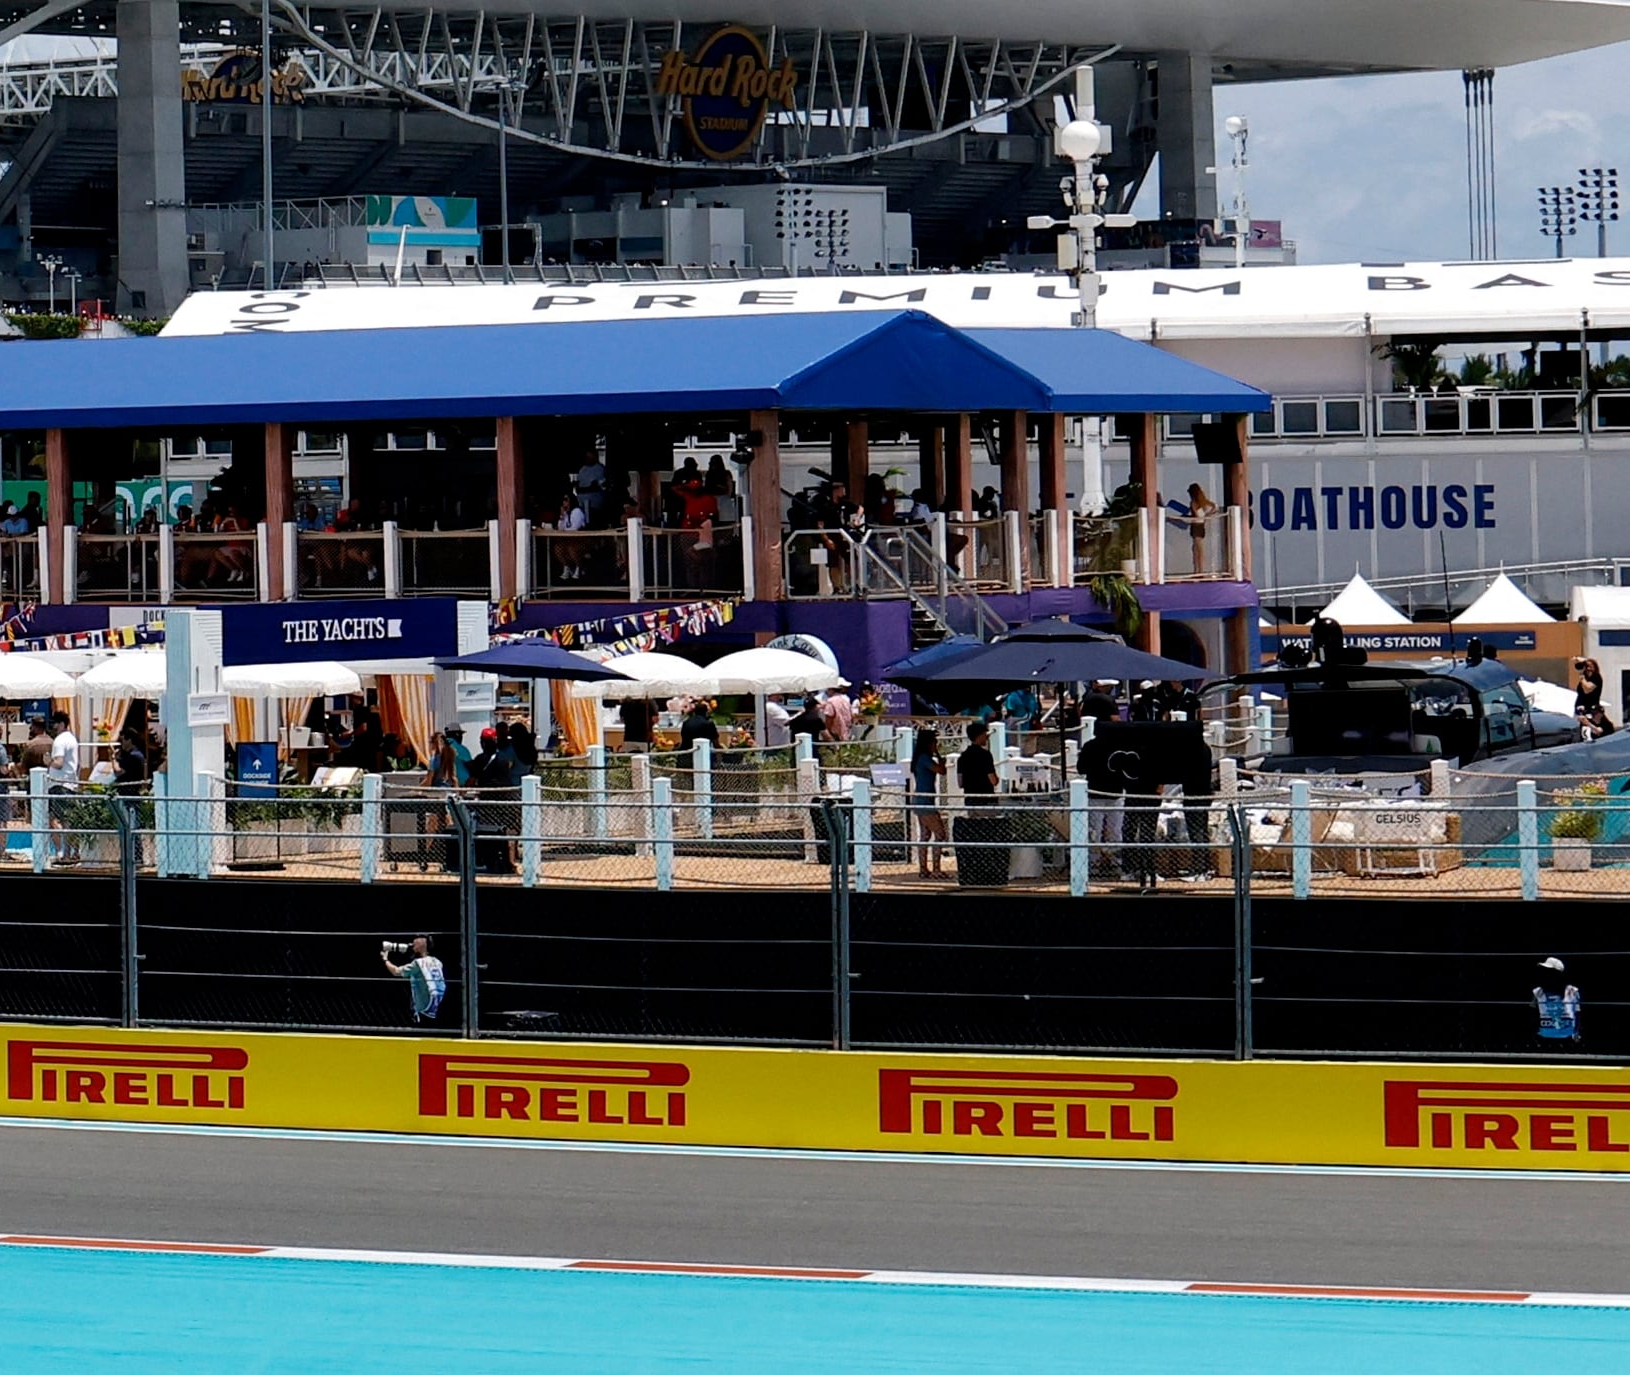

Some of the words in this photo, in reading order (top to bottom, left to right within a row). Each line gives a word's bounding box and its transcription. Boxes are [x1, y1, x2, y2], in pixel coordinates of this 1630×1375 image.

[656, 50, 733, 96] Hard
[732, 54, 799, 108] Rock
[699, 116, 748, 131] STADIUM
[283, 619, 319, 643] THE
[323, 617, 385, 641] YACHTS
[1282, 637, 1312, 649] WAT
[1384, 636, 1441, 648] STATION
[1375, 813, 1421, 824] CELSIUS
[7, 1038, 250, 1111] PIRELLI
[418, 1052, 692, 1127] PIRELLI
[878, 1067, 1179, 1142] PIRELLI
